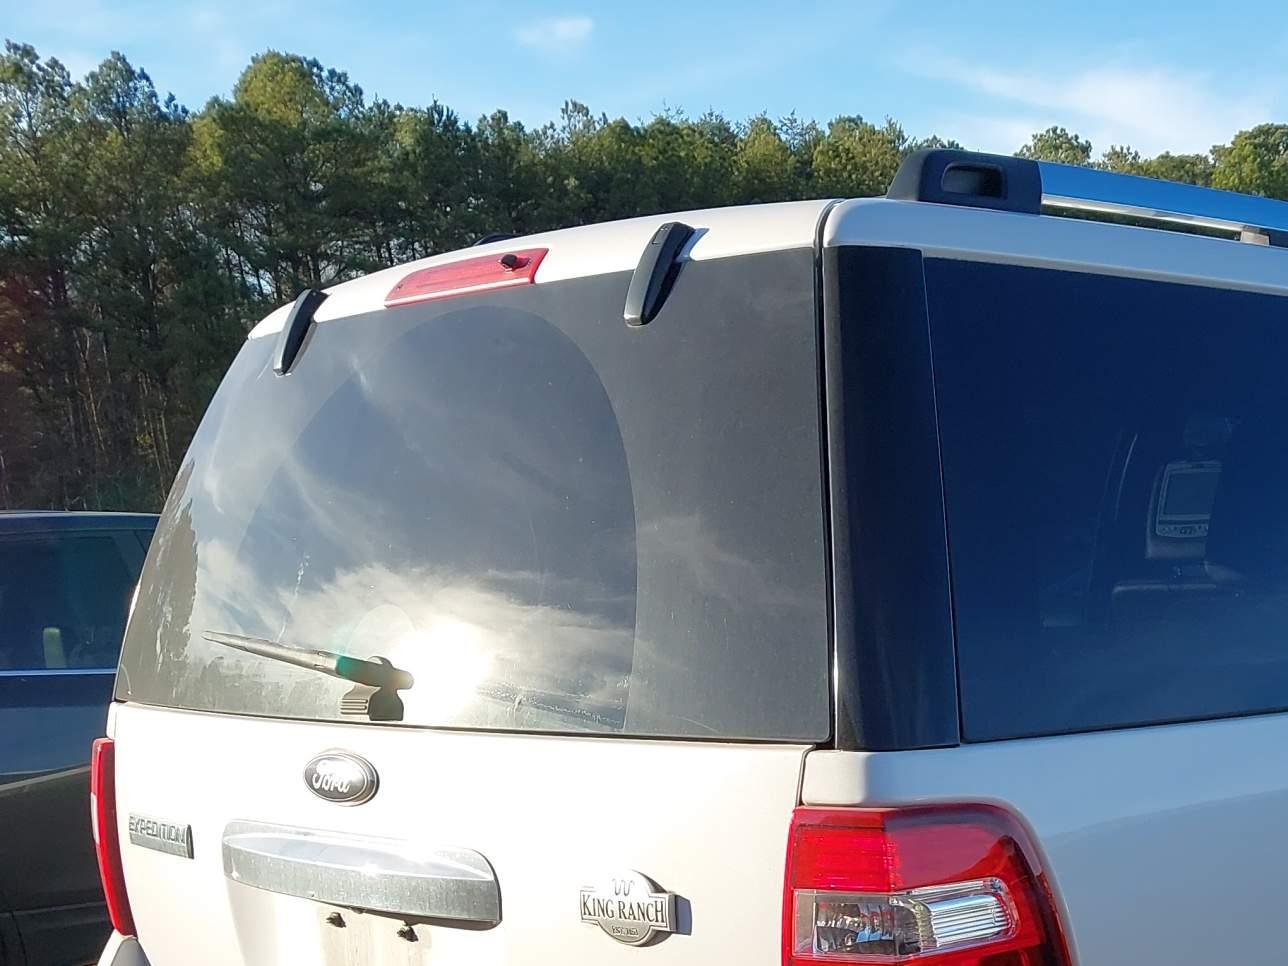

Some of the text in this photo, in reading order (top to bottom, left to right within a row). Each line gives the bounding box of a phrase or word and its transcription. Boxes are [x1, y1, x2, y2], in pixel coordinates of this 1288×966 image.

[129, 815, 187, 844] EXPEDITION
[582, 894, 665, 923] KING RANCH
